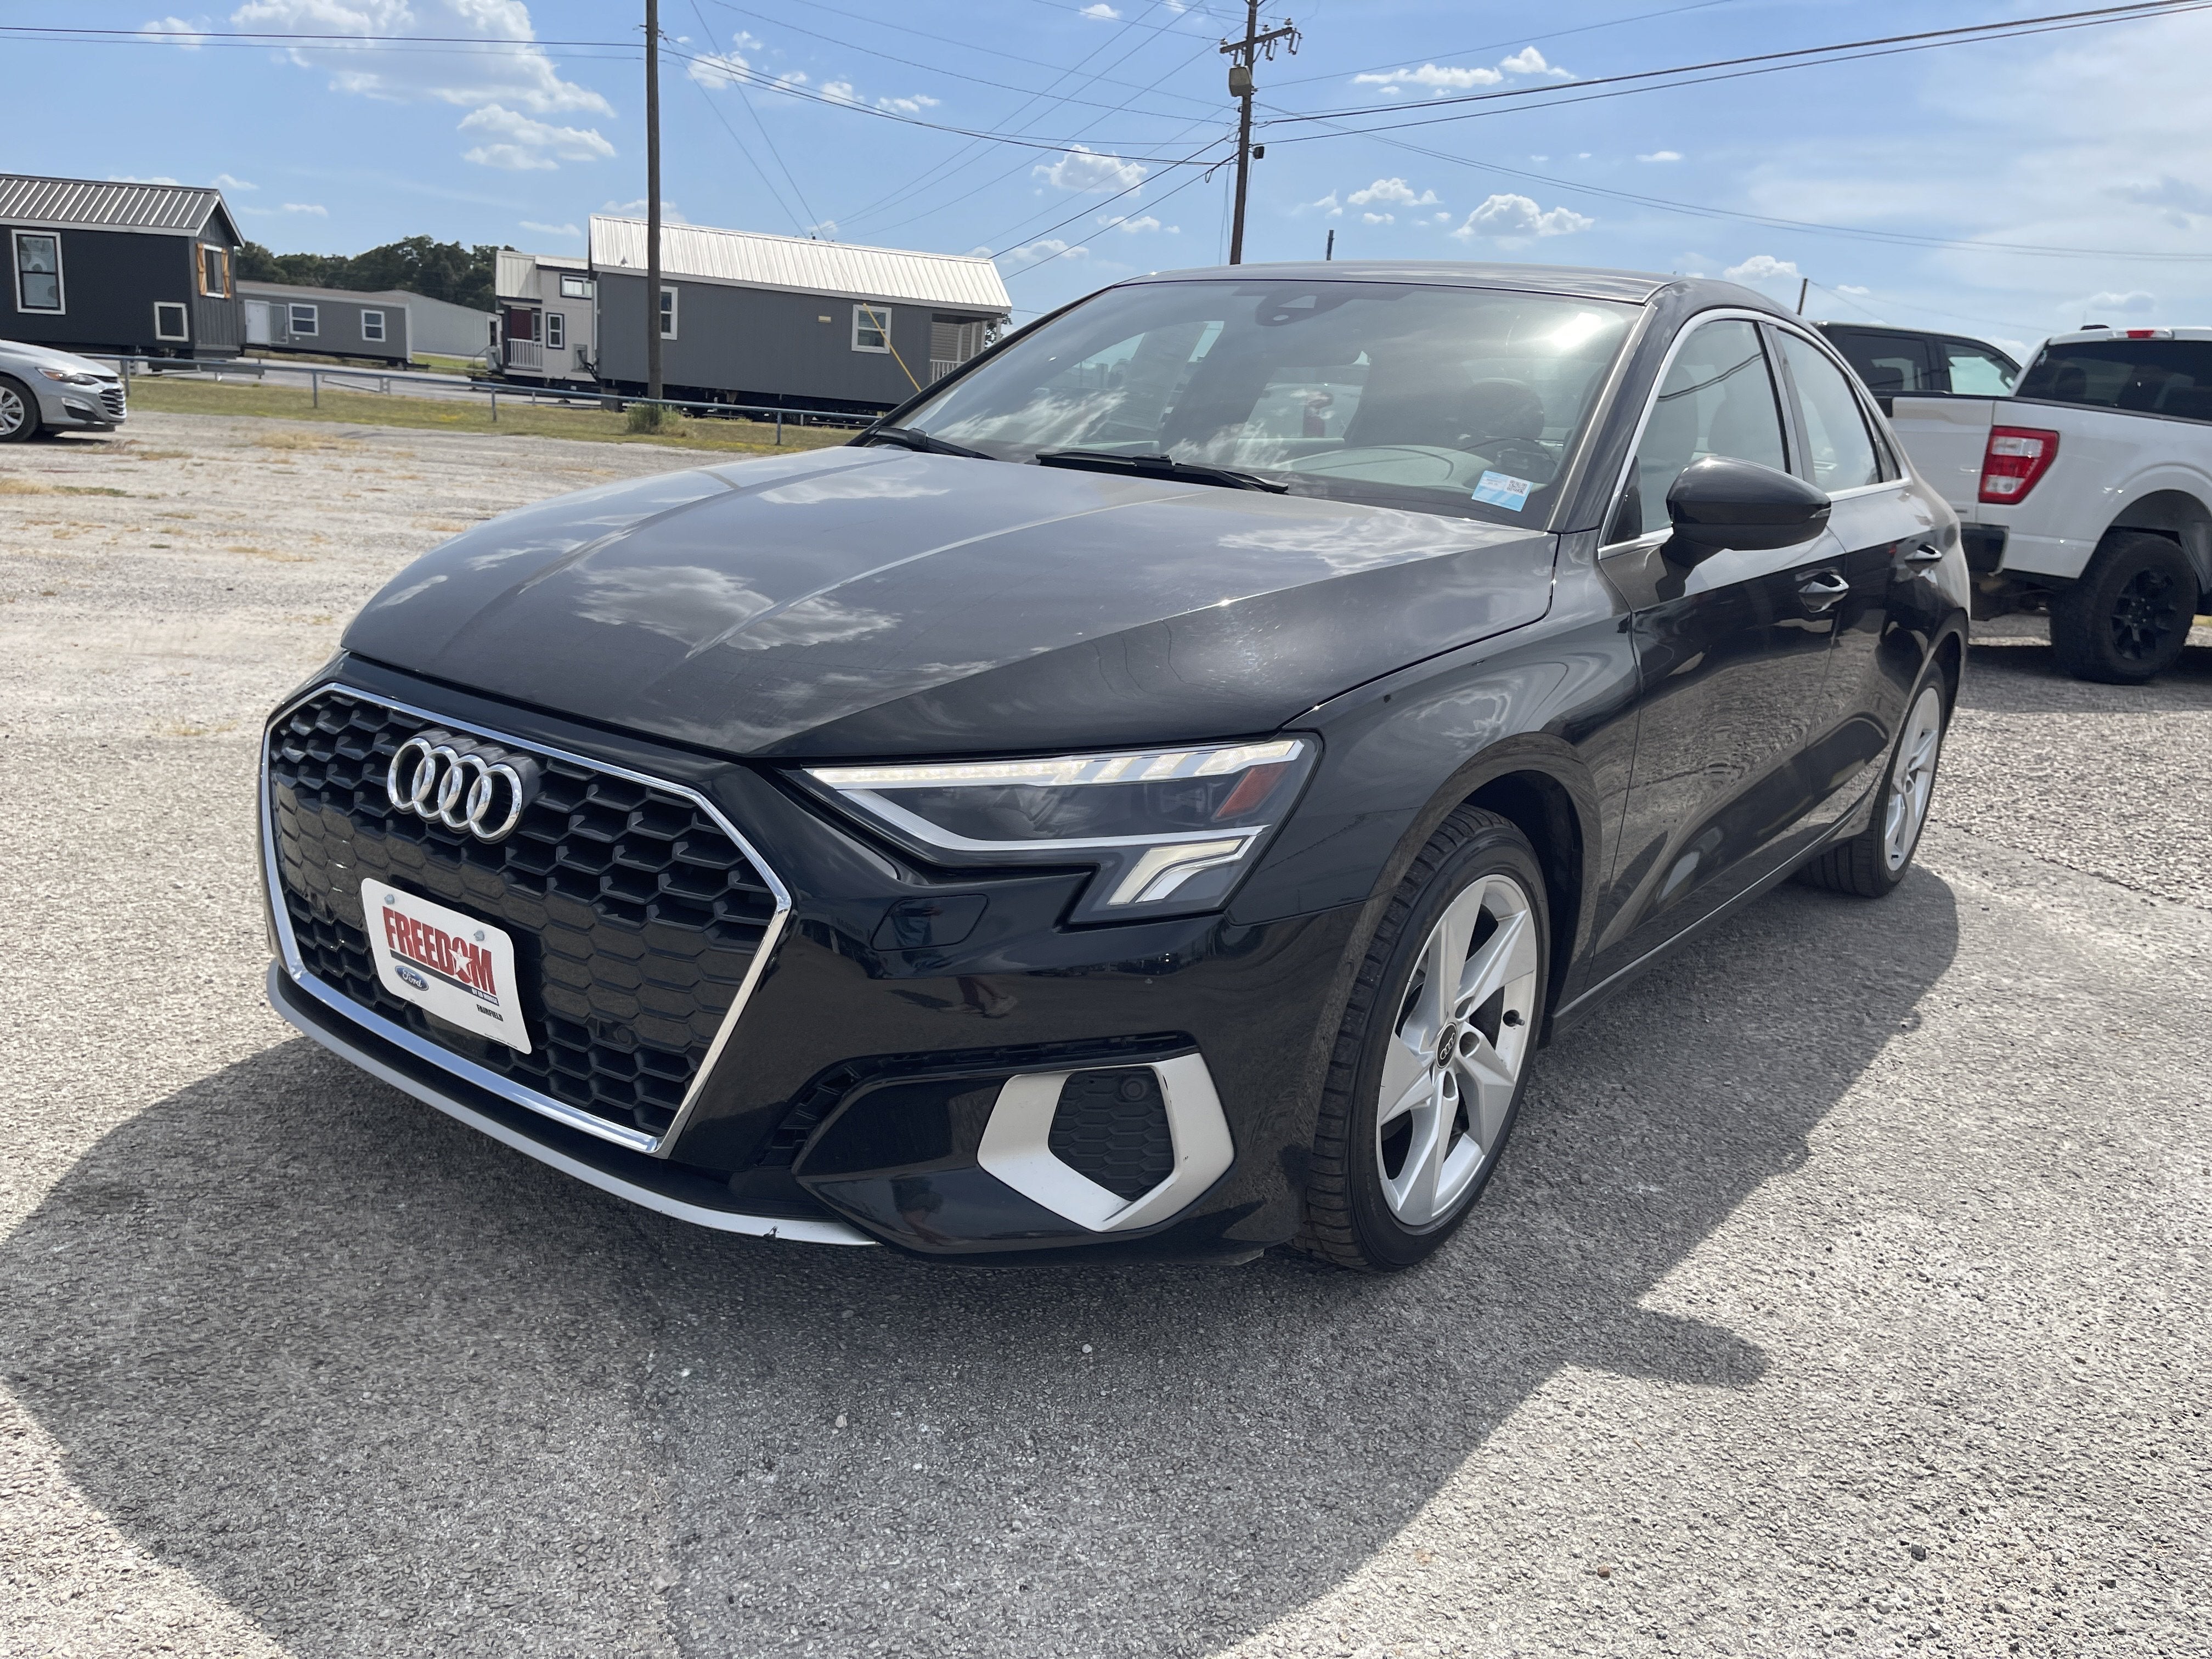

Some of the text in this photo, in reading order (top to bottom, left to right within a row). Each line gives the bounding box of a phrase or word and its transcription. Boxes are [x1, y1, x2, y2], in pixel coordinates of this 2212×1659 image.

[382, 906, 496, 996] FREEDOM
[402, 969, 422, 988] Ford
[476, 1004, 504, 1022] FAIRFIELD
